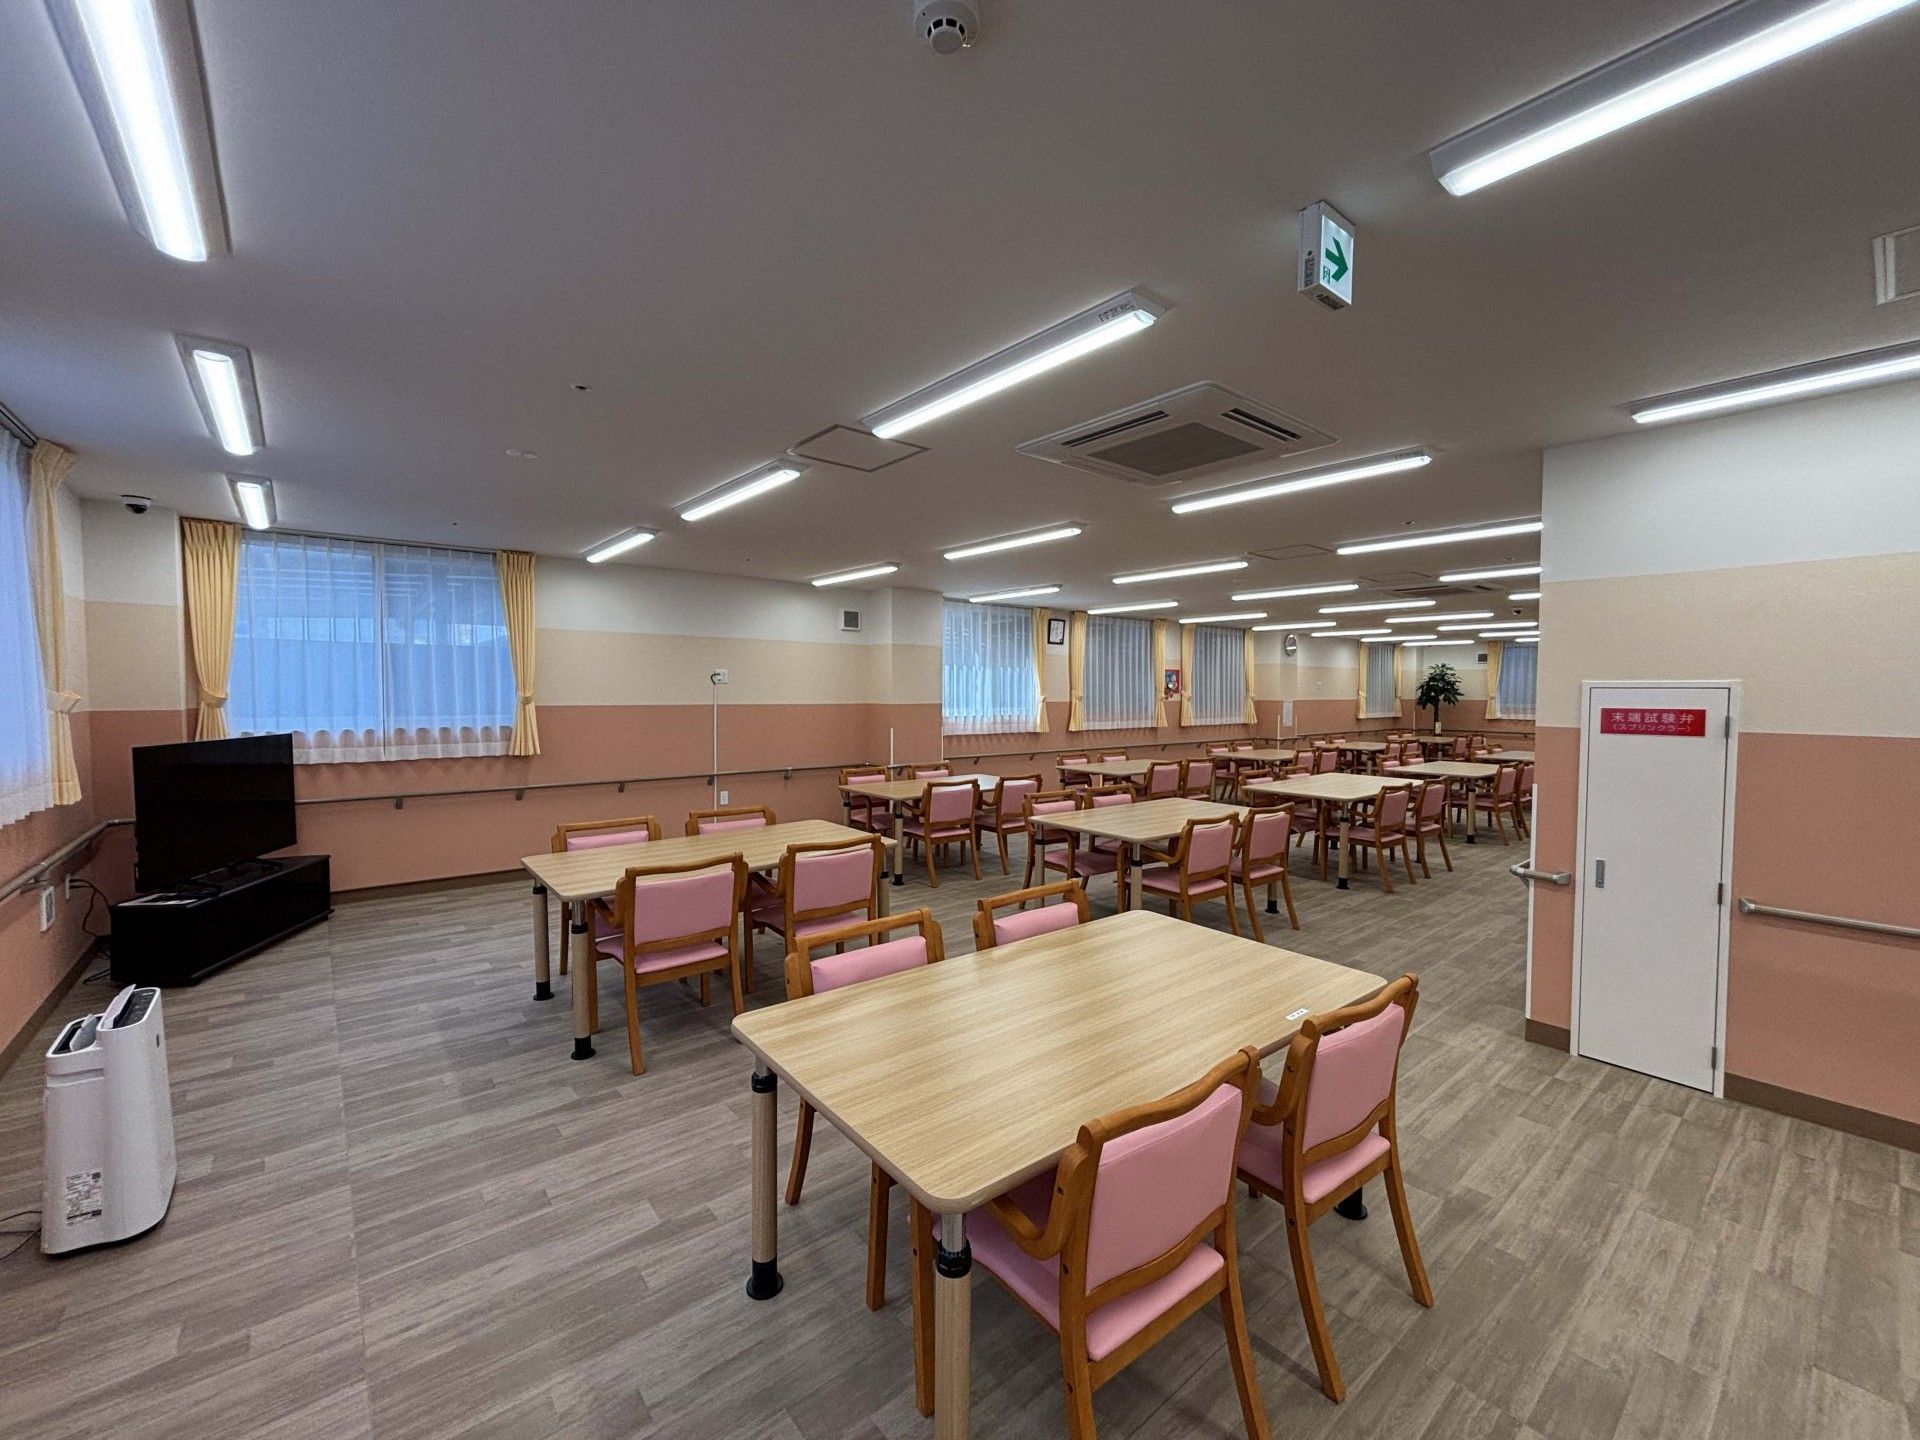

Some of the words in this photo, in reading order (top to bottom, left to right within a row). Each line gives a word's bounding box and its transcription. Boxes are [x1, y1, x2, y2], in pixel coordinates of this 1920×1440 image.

[1611, 712, 1695, 724] 末端試験弁
